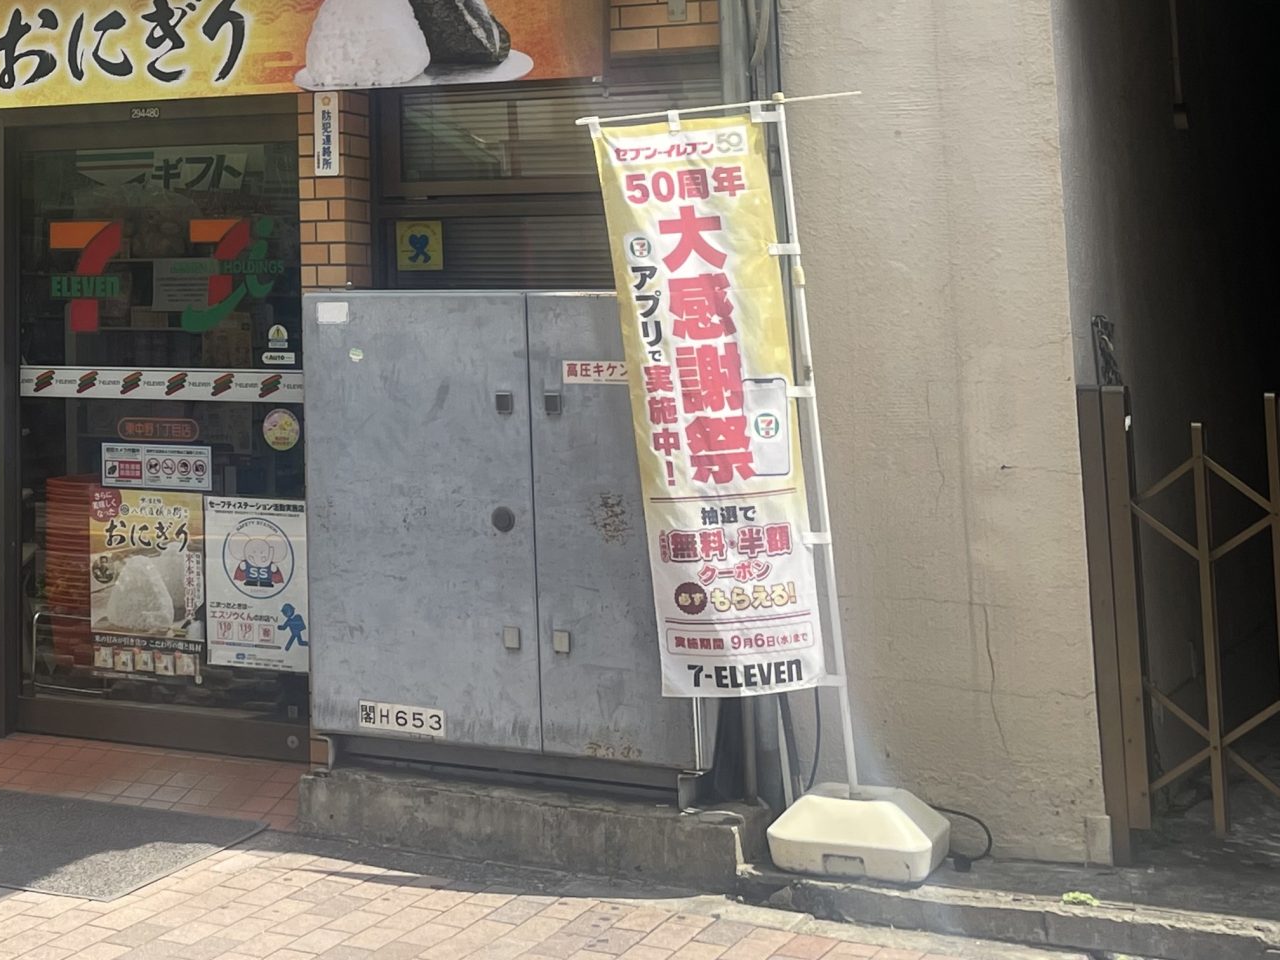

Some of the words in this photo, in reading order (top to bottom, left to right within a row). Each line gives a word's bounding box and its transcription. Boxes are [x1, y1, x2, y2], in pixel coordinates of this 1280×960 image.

[131, 107, 159, 118] 294480
[321, 110, 332, 170] 防犯連絡所
[625, 166, 745, 204] 50周年
[658, 205, 757, 484] 大感謝祭
[566, 363, 628, 377] 高圧キケン
[94, 492, 112, 500] さらに
[701, 506, 756, 525] 抽選で
[105, 520, 188, 552] おにぎり
[249, 567, 268, 578] SS
[699, 562, 771, 584] クーポン
